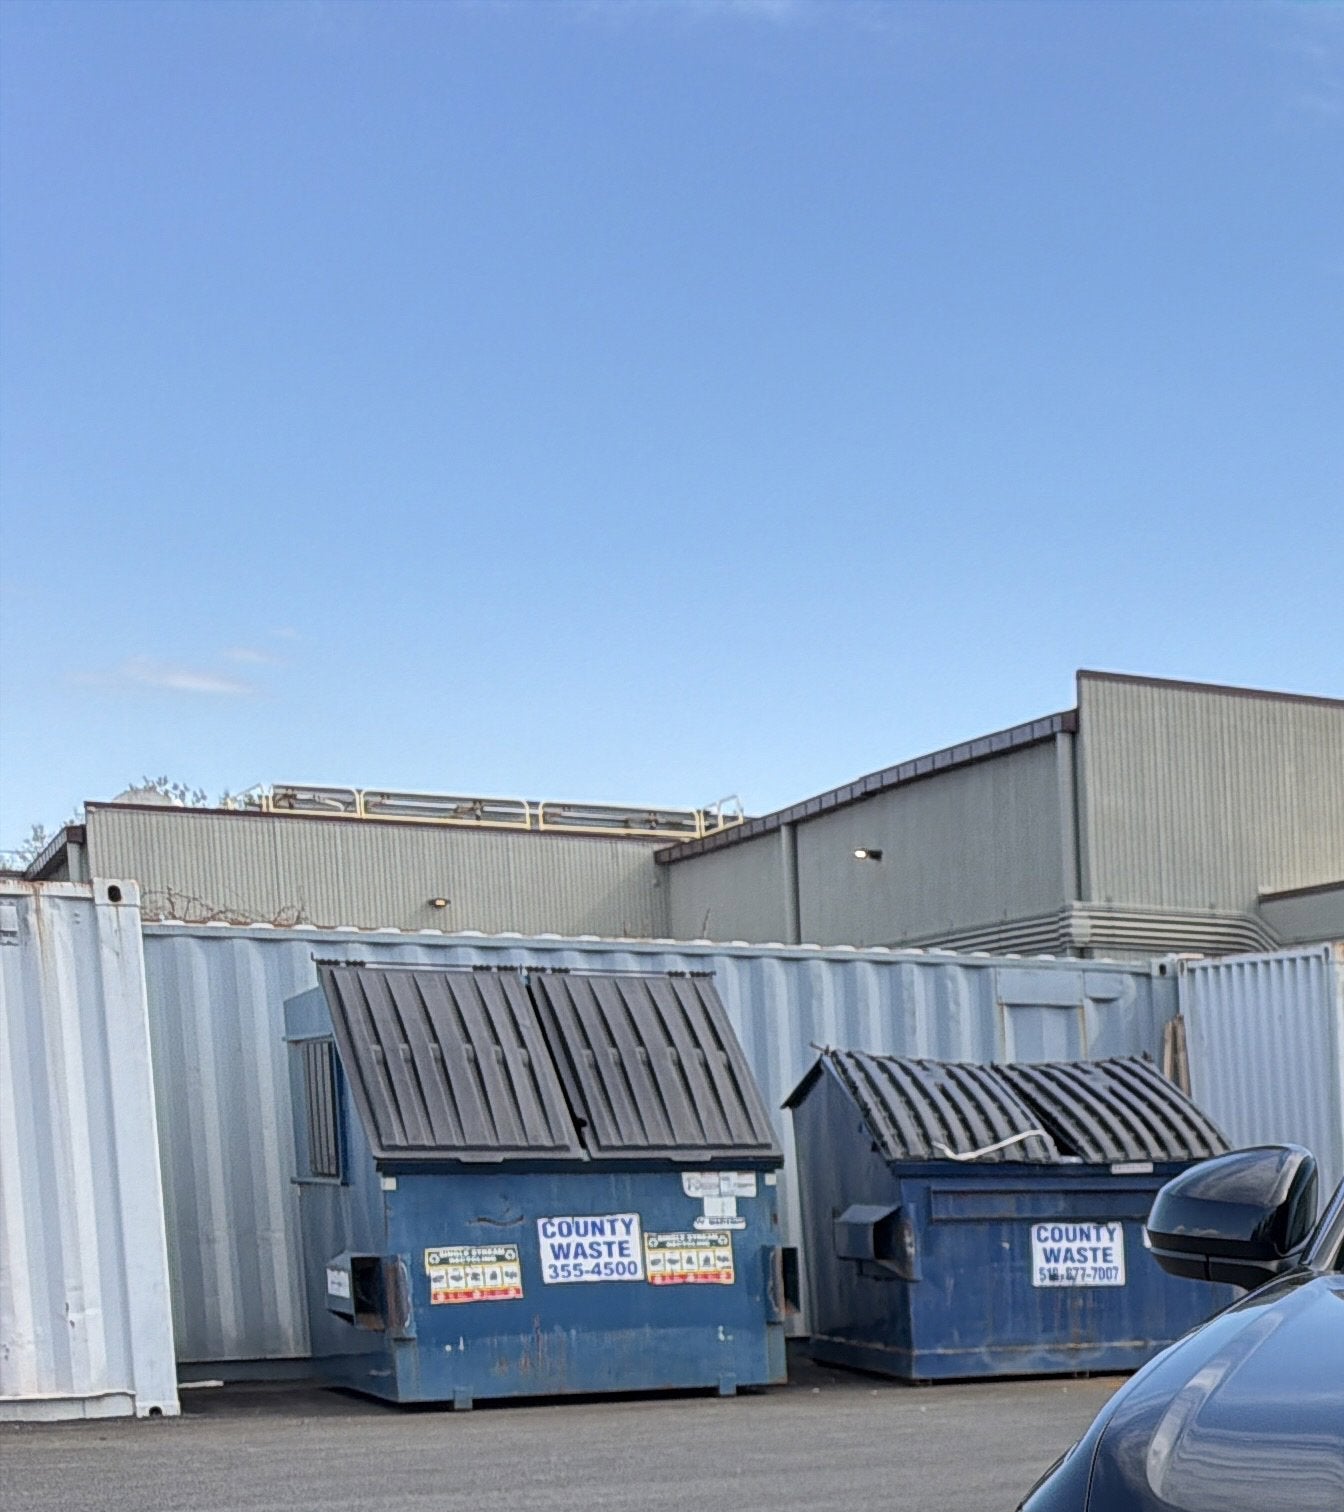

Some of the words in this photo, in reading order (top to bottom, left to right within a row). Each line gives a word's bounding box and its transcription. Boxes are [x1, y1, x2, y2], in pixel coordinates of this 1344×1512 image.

[541, 1217, 634, 1239] COUNTY
[1036, 1225, 1117, 1243] COUNTY
[549, 1240, 632, 1261] WASTE
[1042, 1246, 1114, 1264] WASTE
[547, 1260, 639, 1280] 355-4500
